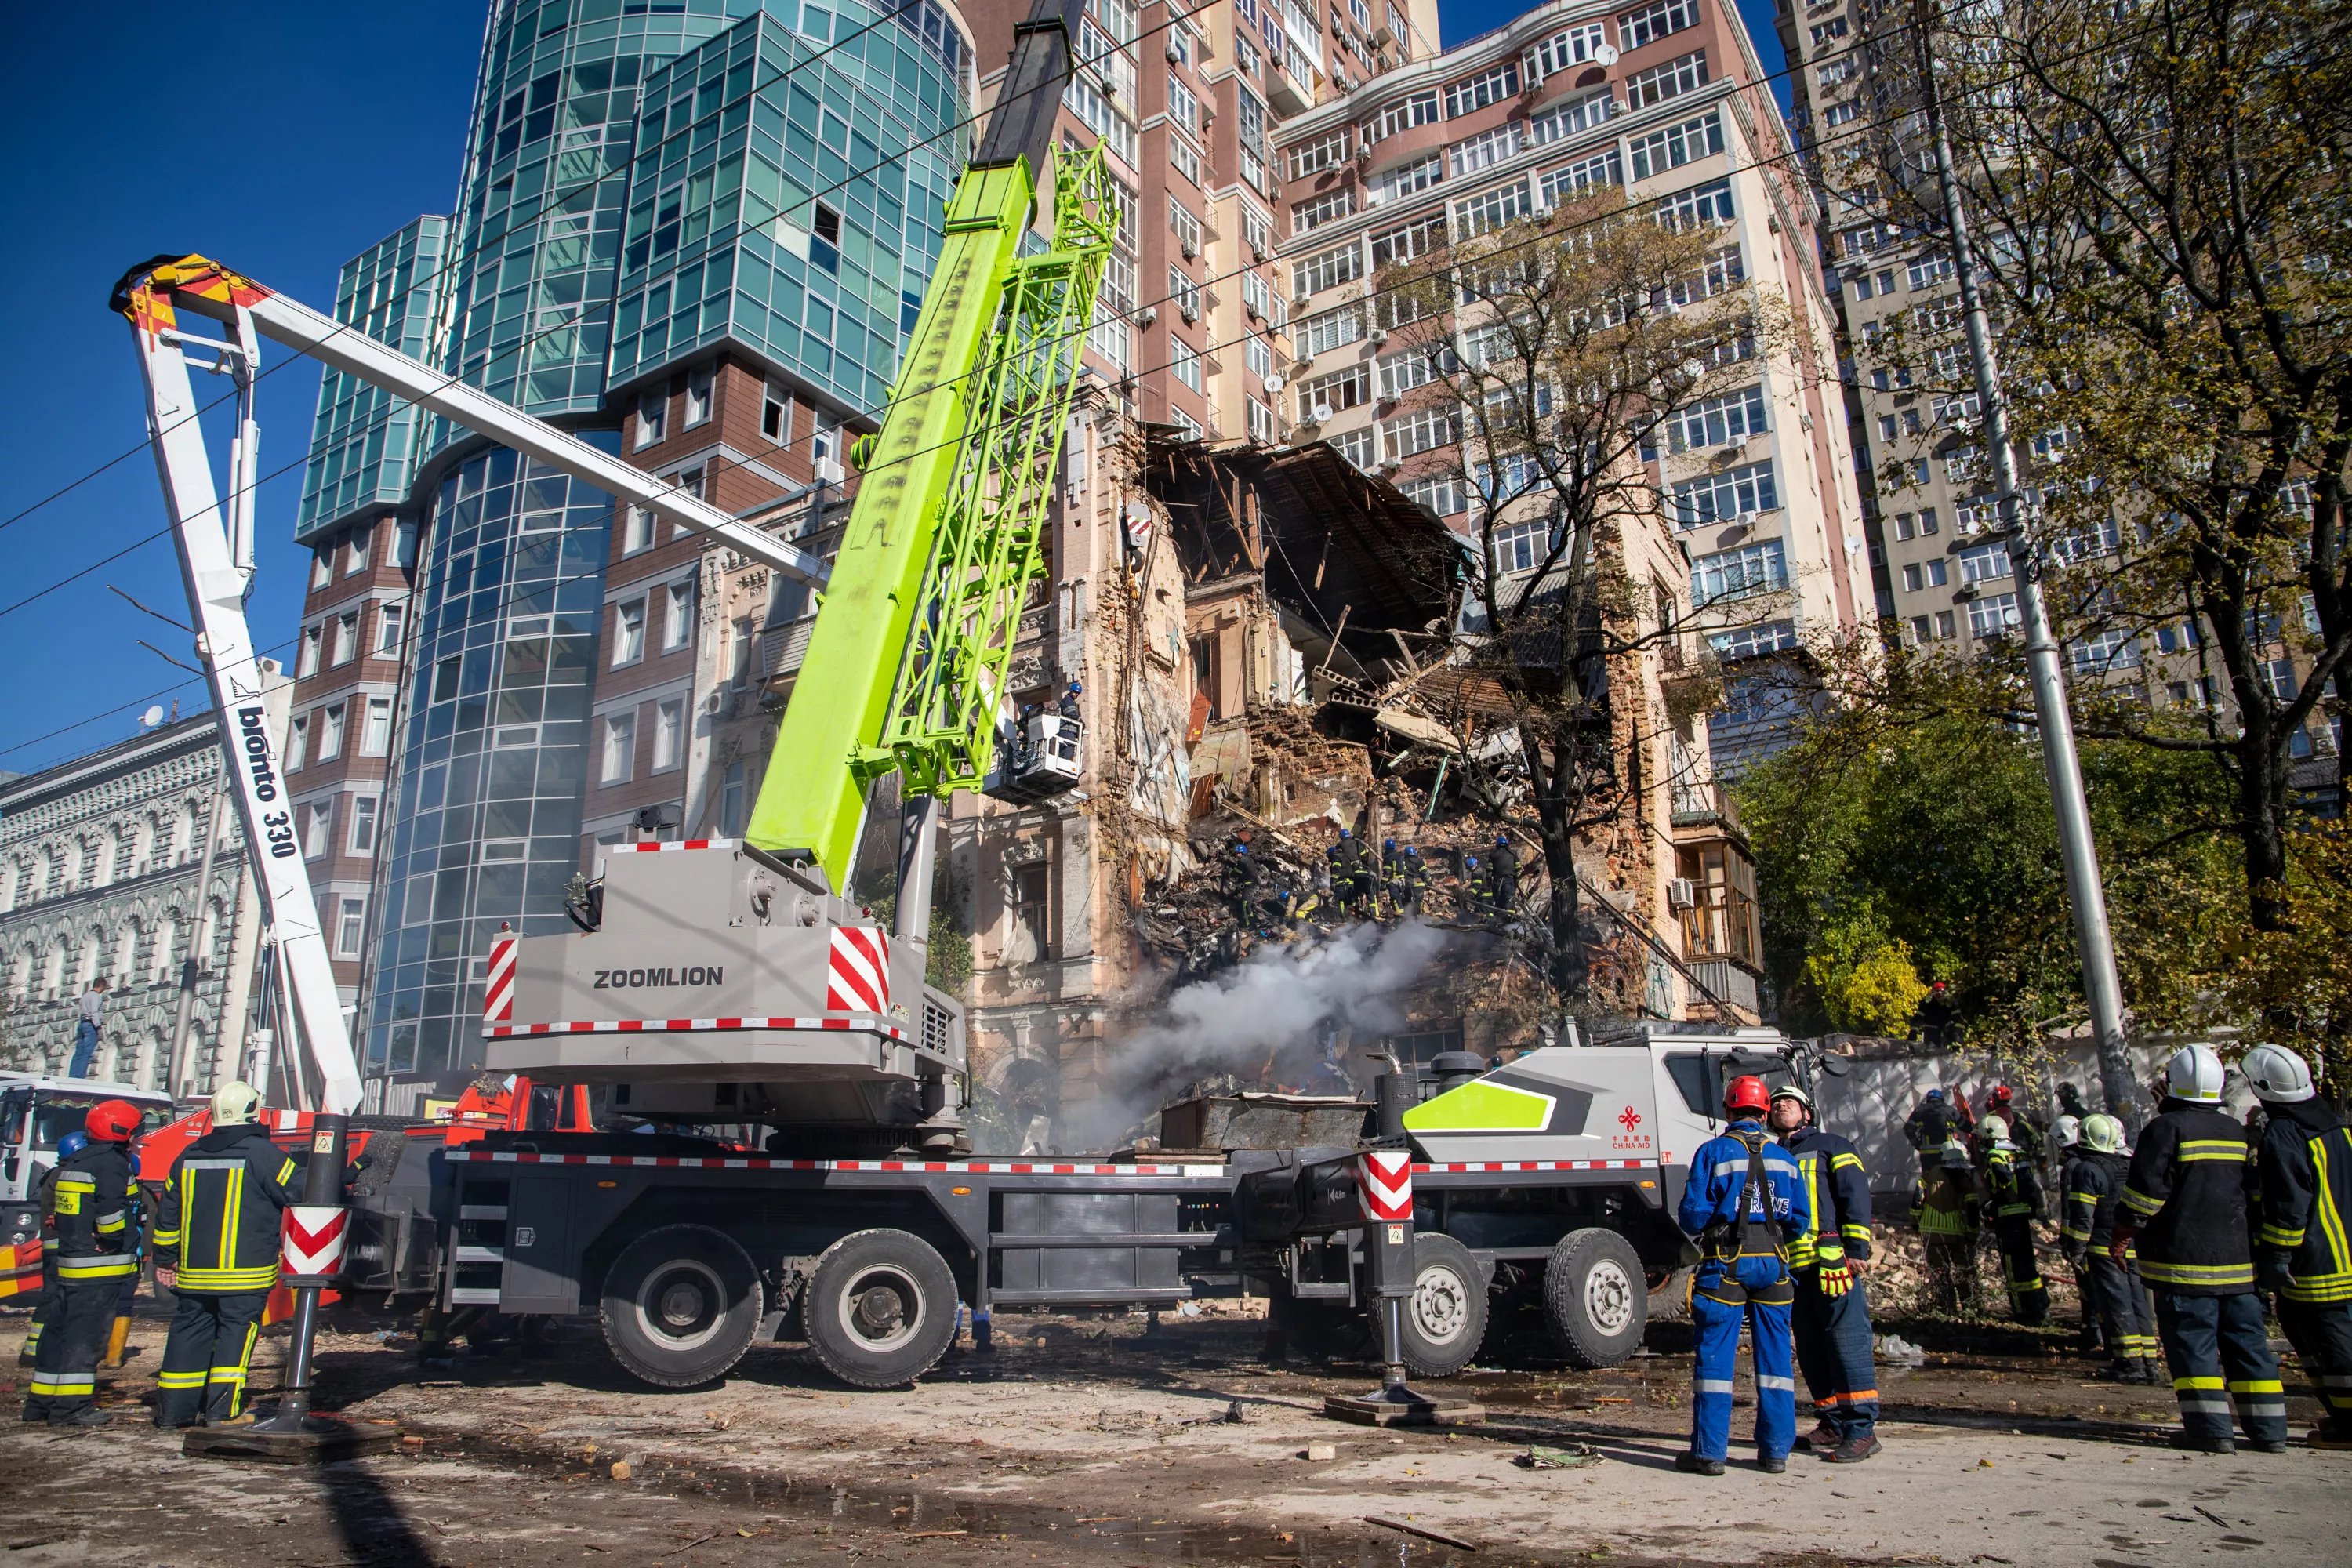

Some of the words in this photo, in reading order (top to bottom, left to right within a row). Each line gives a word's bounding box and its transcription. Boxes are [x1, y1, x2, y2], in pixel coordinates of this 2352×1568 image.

[962, 324, 989, 417] ZOOMLION
[238, 706, 277, 803] bronto
[263, 811, 296, 858] 330
[593, 967, 723, 989] ZOOMLION
